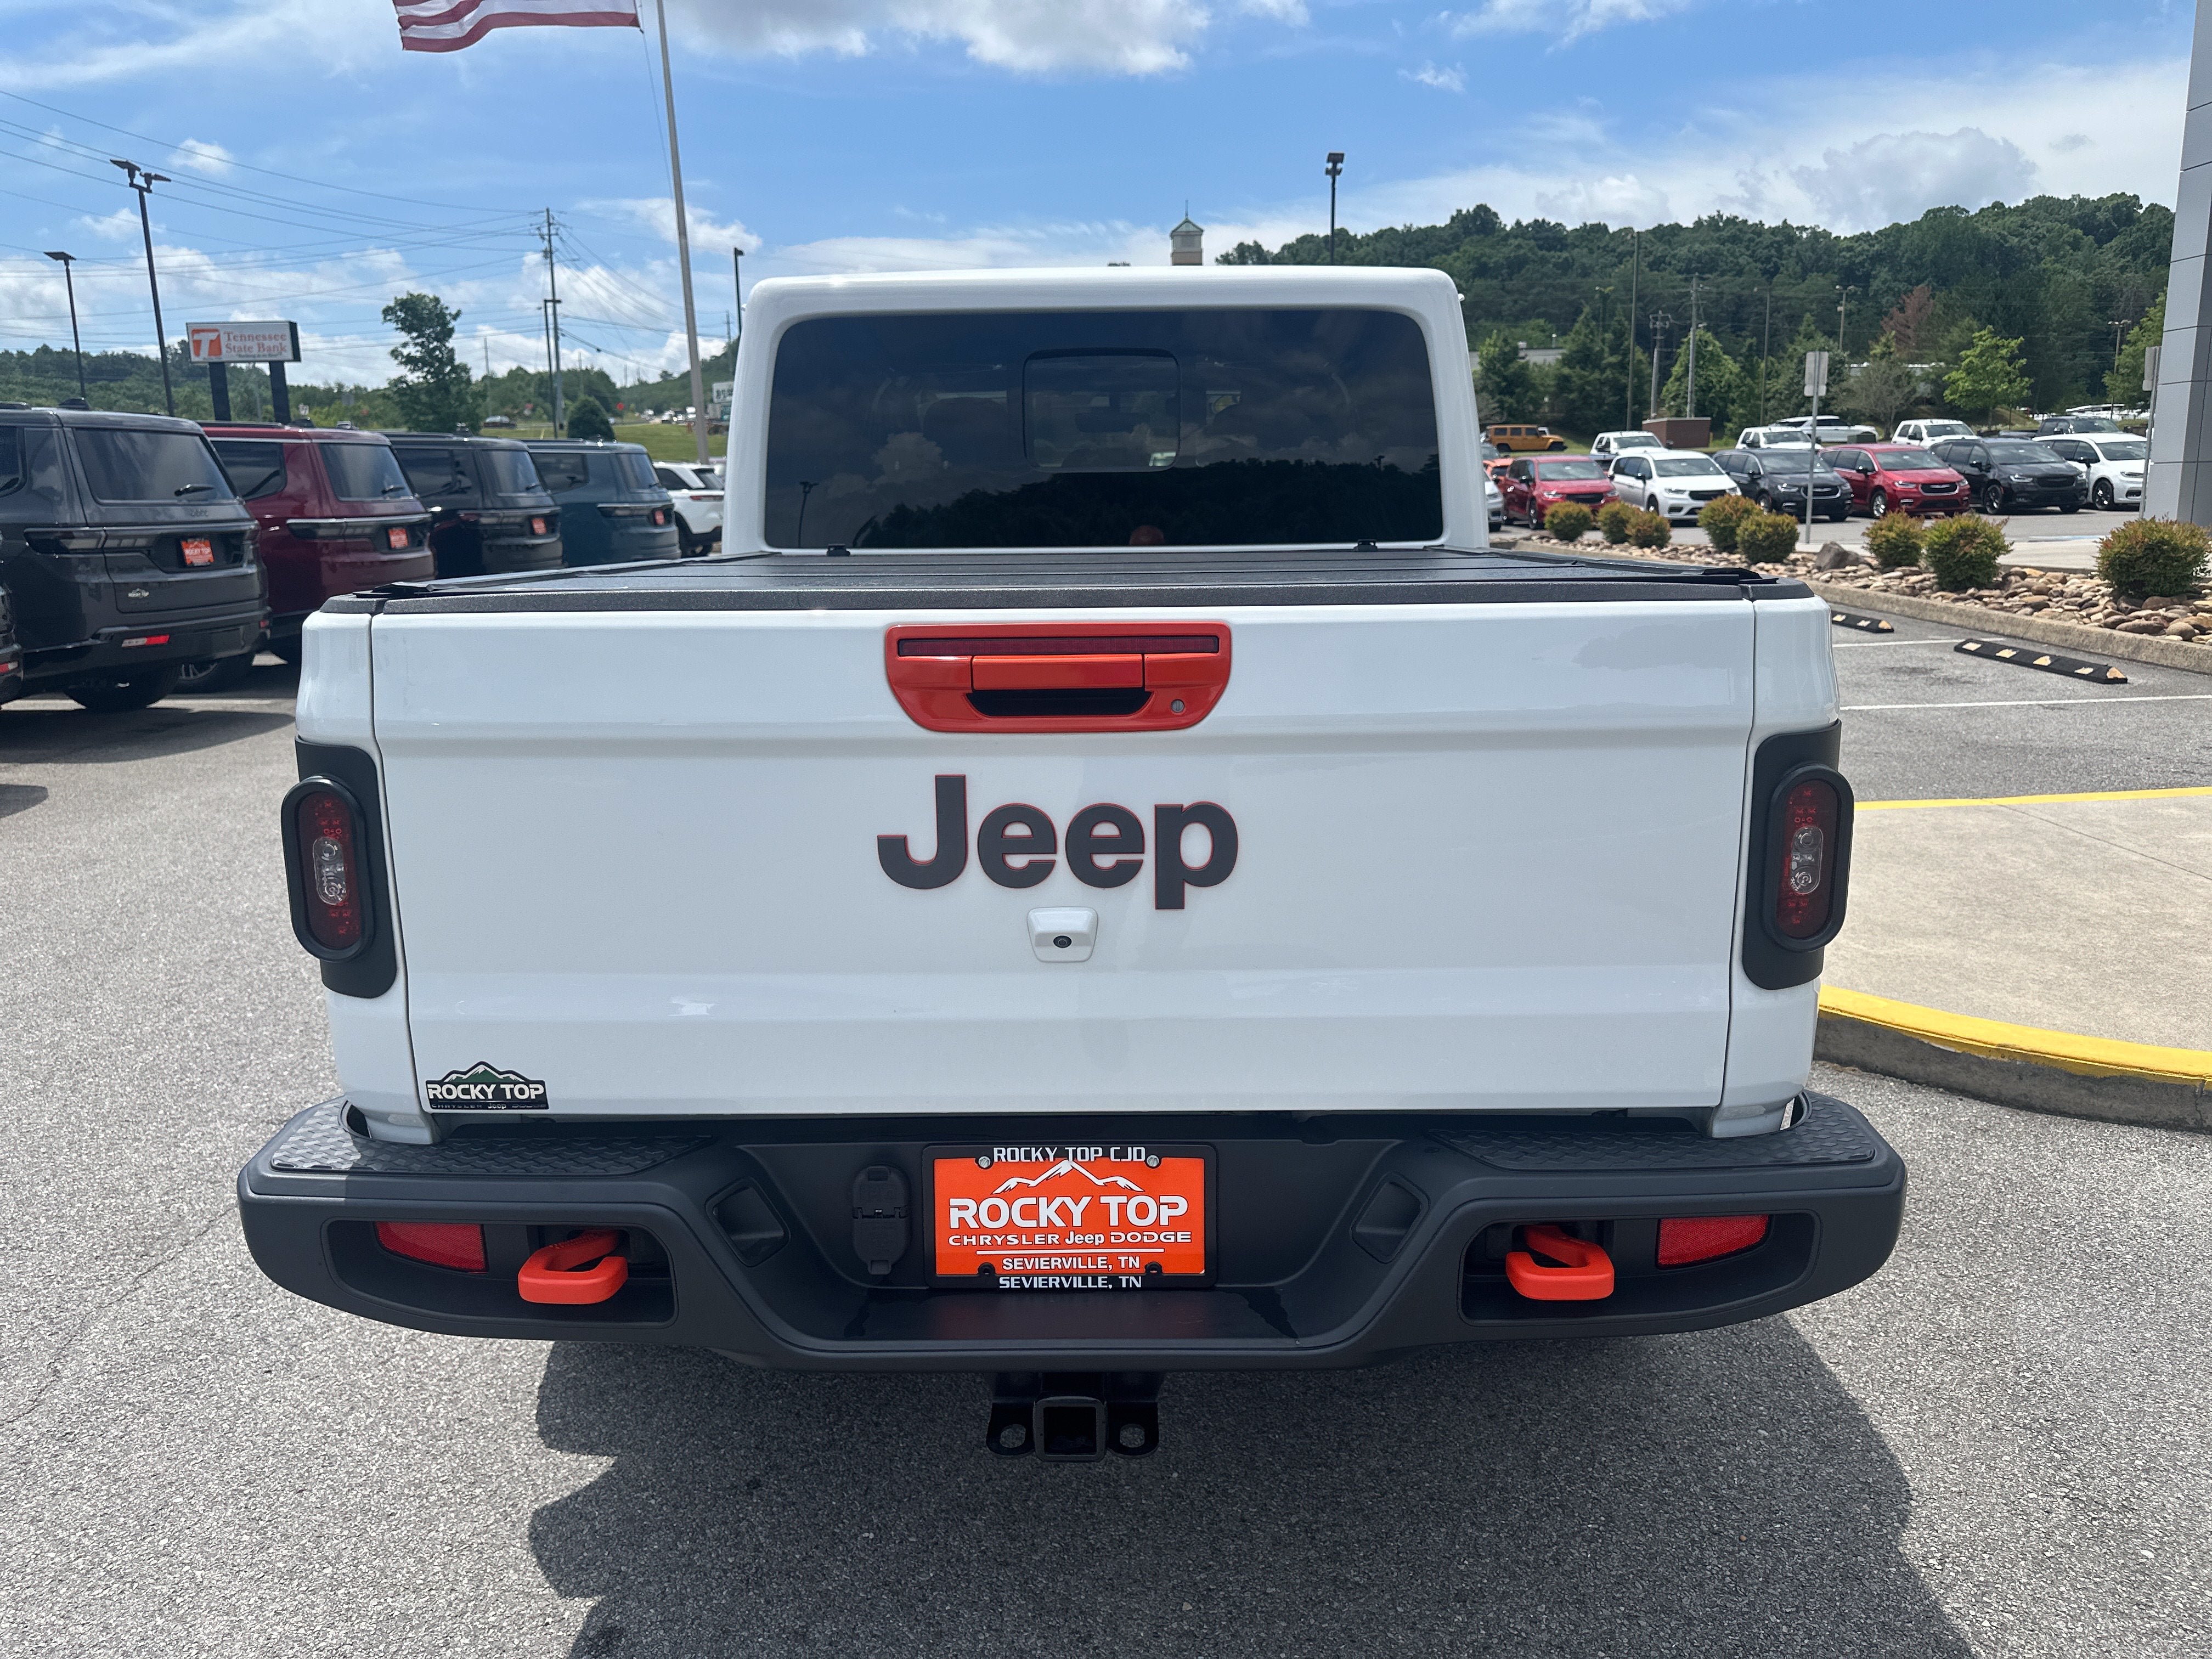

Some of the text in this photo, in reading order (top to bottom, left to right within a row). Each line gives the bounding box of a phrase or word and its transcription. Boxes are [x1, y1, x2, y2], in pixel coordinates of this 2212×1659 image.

[223, 331, 287, 342] Tennessee
[225, 342, 286, 353] State Bank
[877, 774, 1238, 910] Jeep
[427, 1084, 544, 1099] ROCKY TOP
[994, 1147, 1146, 1162] ROCKY TOP CJD
[949, 1195, 1189, 1229] ROCKY TOP
[949, 1231, 1192, 1246] CHRYSLER Jeep DODGE
[1002, 1256, 1140, 1271] SEVIERVILLE, TN
[999, 1276, 1142, 1289] SEVIERVILLE, TN
